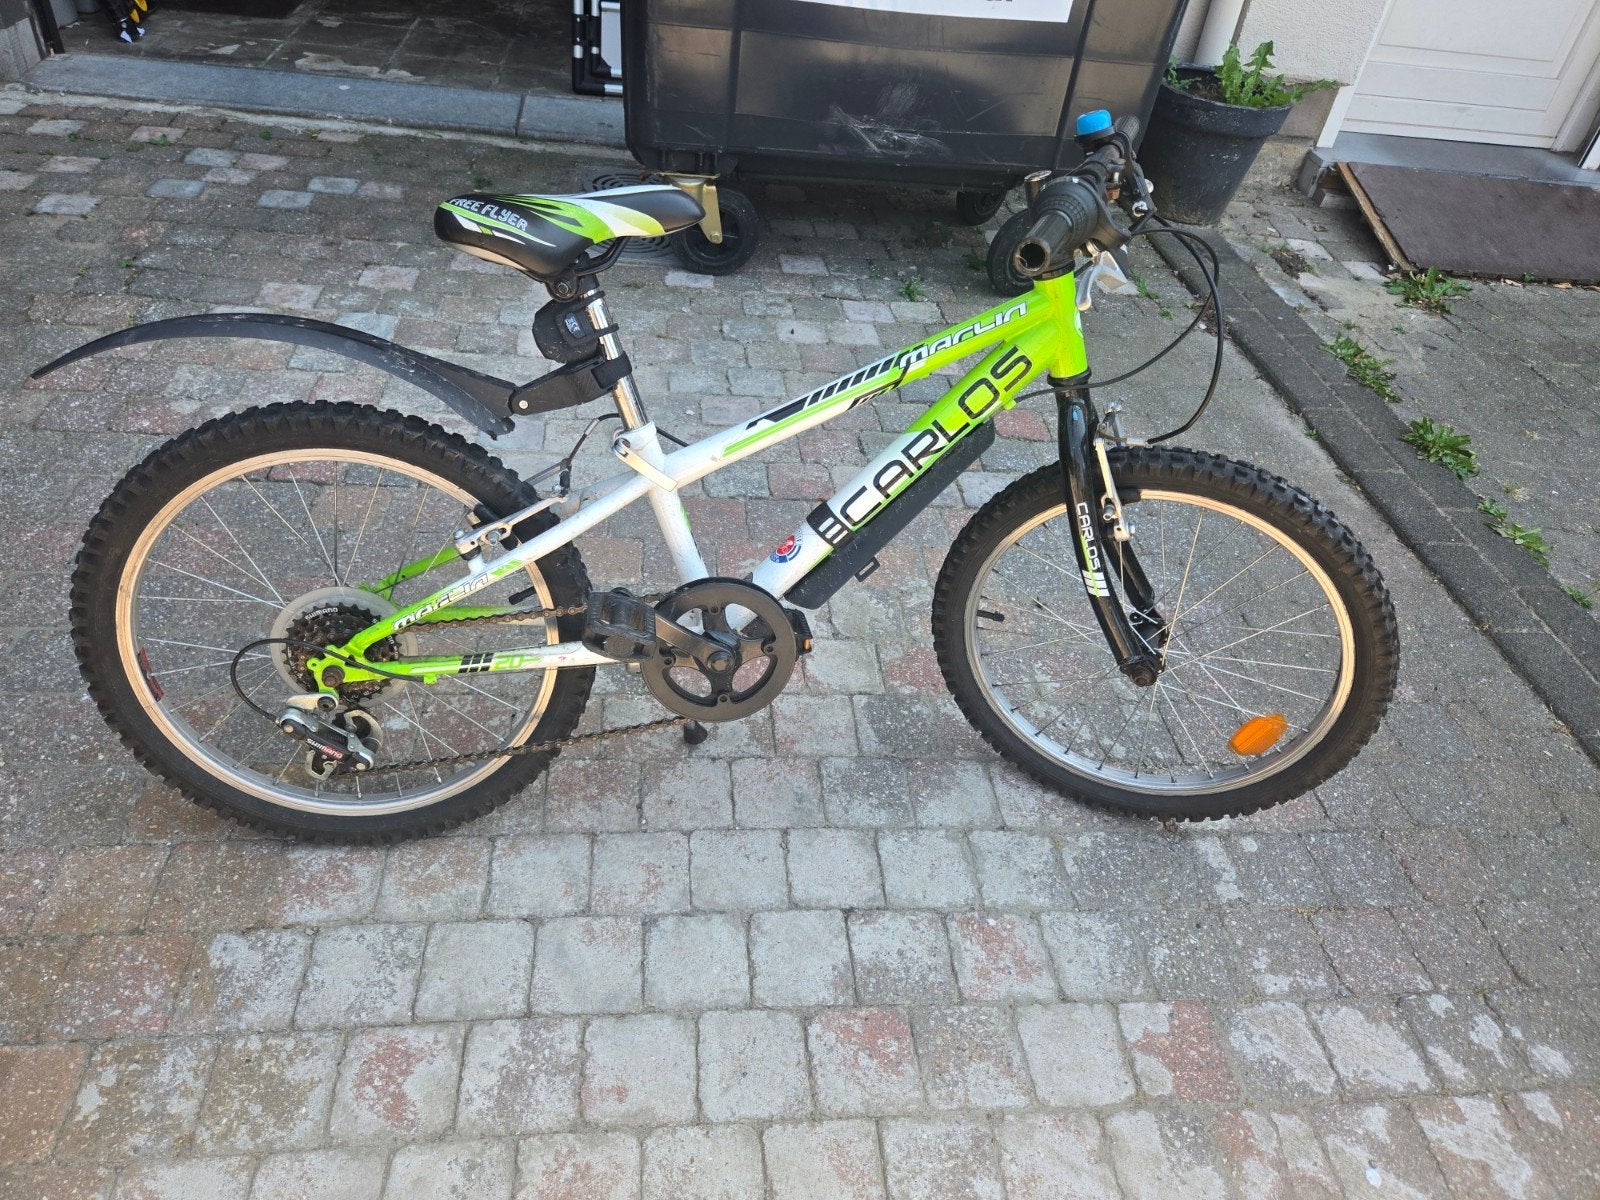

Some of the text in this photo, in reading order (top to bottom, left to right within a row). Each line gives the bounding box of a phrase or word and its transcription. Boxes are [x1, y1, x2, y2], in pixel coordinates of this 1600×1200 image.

[449, 198, 528, 231] FREE FLYER
[839, 345, 1033, 527] CARLOS
[1077, 502, 1101, 571] CARLOS
[305, 607, 338, 620] SHIMANO
[495, 655, 523, 670] 20
[305, 738, 344, 759] SHIMANO
